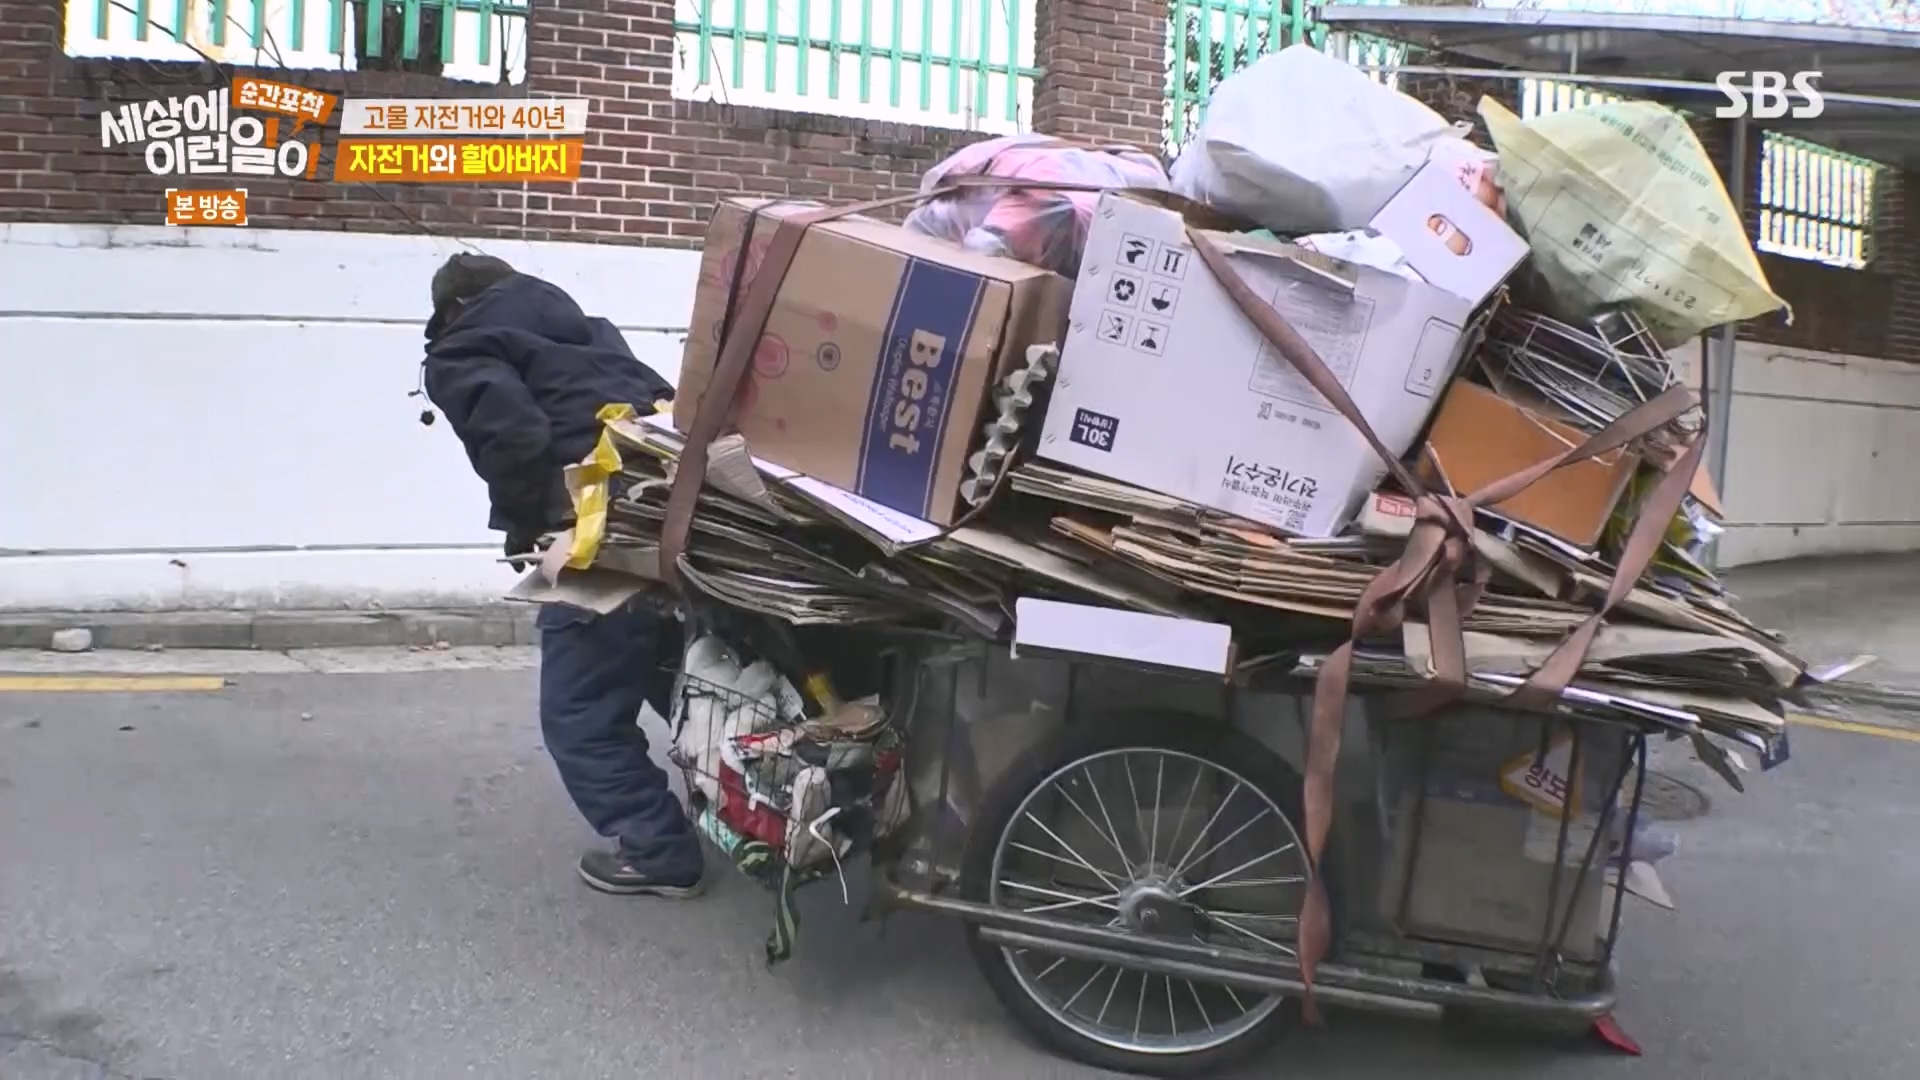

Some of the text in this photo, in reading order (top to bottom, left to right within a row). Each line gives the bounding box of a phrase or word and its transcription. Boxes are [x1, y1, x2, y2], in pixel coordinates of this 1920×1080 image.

[889, 328, 947, 455] Best
[1077, 423, 1111, 447] 30L
[1225, 455, 1319, 499] 전기온수기
